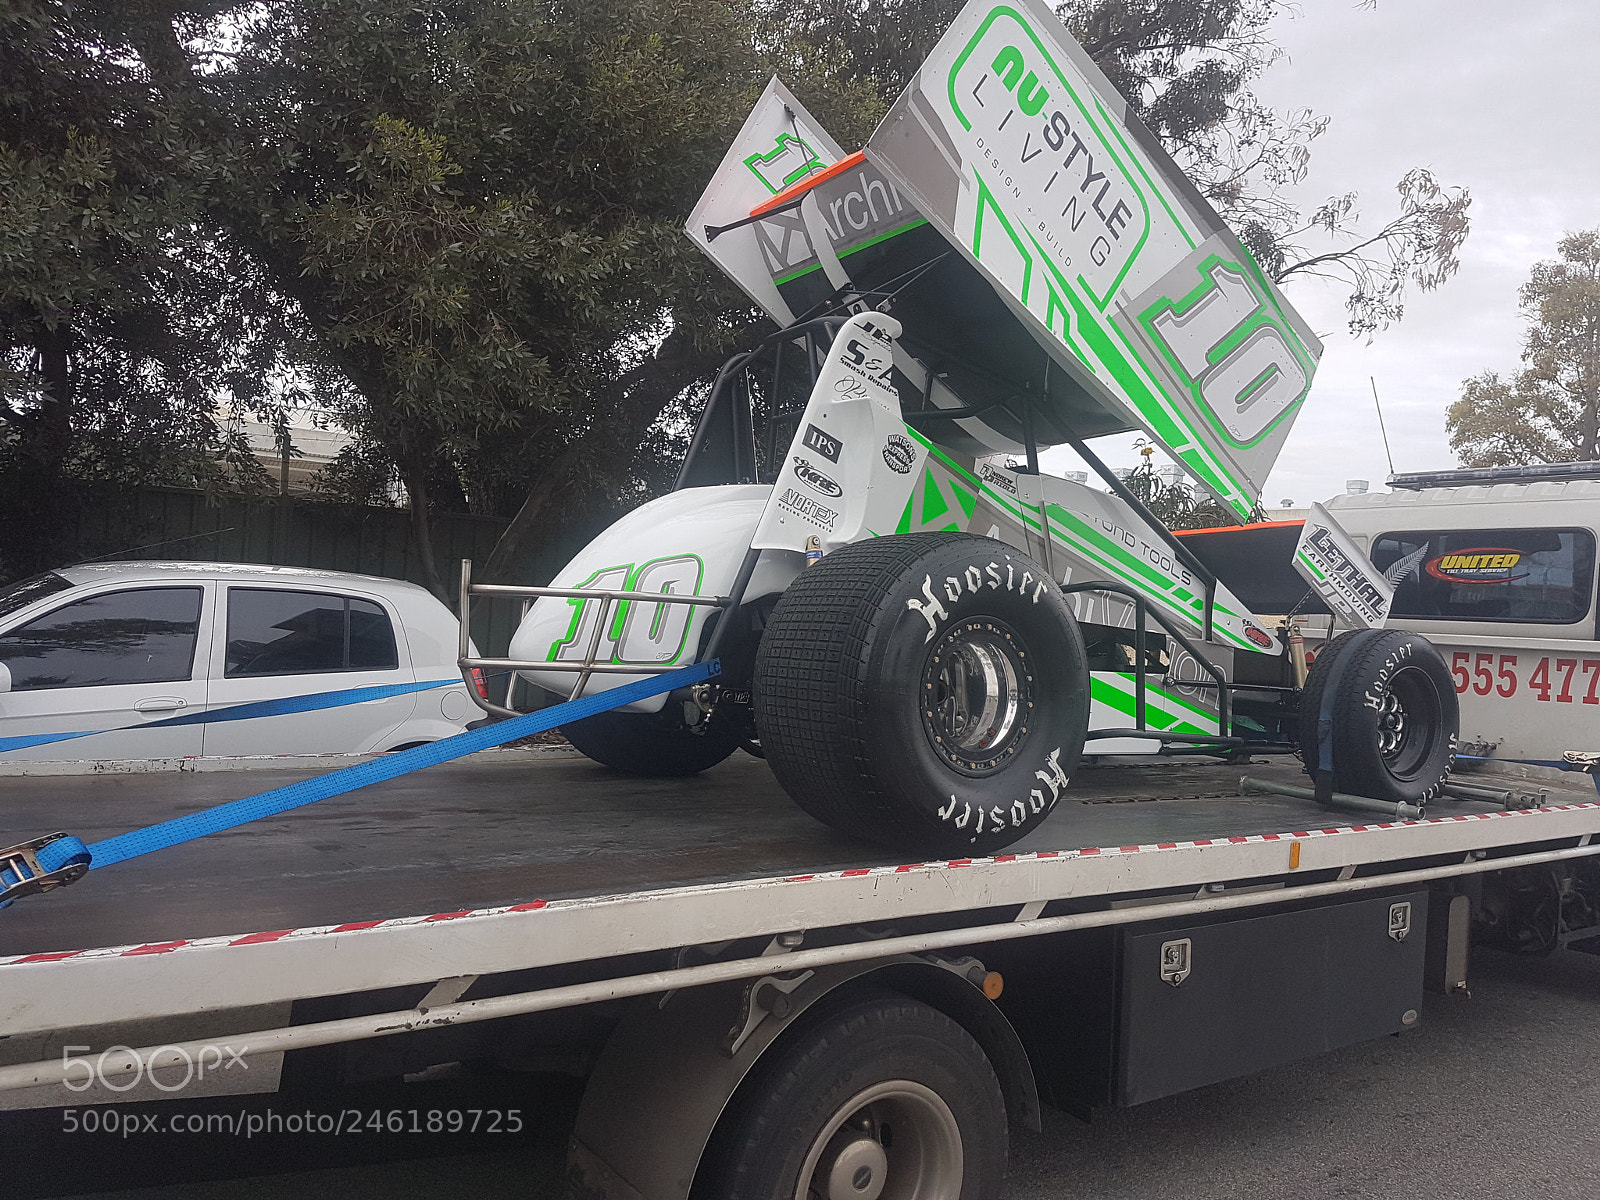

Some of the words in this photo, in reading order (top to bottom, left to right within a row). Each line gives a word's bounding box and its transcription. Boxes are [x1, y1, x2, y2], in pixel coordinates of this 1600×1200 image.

[743, 133, 828, 195] 1
[972, 73, 1111, 267] LIVING
[976, 137, 1021, 198] DESIGN
[1038, 221, 1072, 267] BUILD
[840, 357, 867, 378] Smash
[867, 374, 899, 397] Repairs
[1137, 253, 1310, 450] 10
[809, 430, 836, 456] IPS
[778, 488, 839, 528] VORTEX
[1140, 541, 1192, 586] TOOLS
[1301, 544, 1376, 623] EARTHMOVING
[1306, 524, 1388, 619] LETHAL
[1440, 554, 1520, 569] UNITED
[546, 553, 704, 665] 10
[906, 554, 1049, 645] Hoosier
[1363, 642, 1412, 711] Hoosier
[1451, 652, 1517, 698] 555
[1528, 657, 1600, 704] 477
[937, 746, 1070, 843] Hoosier
